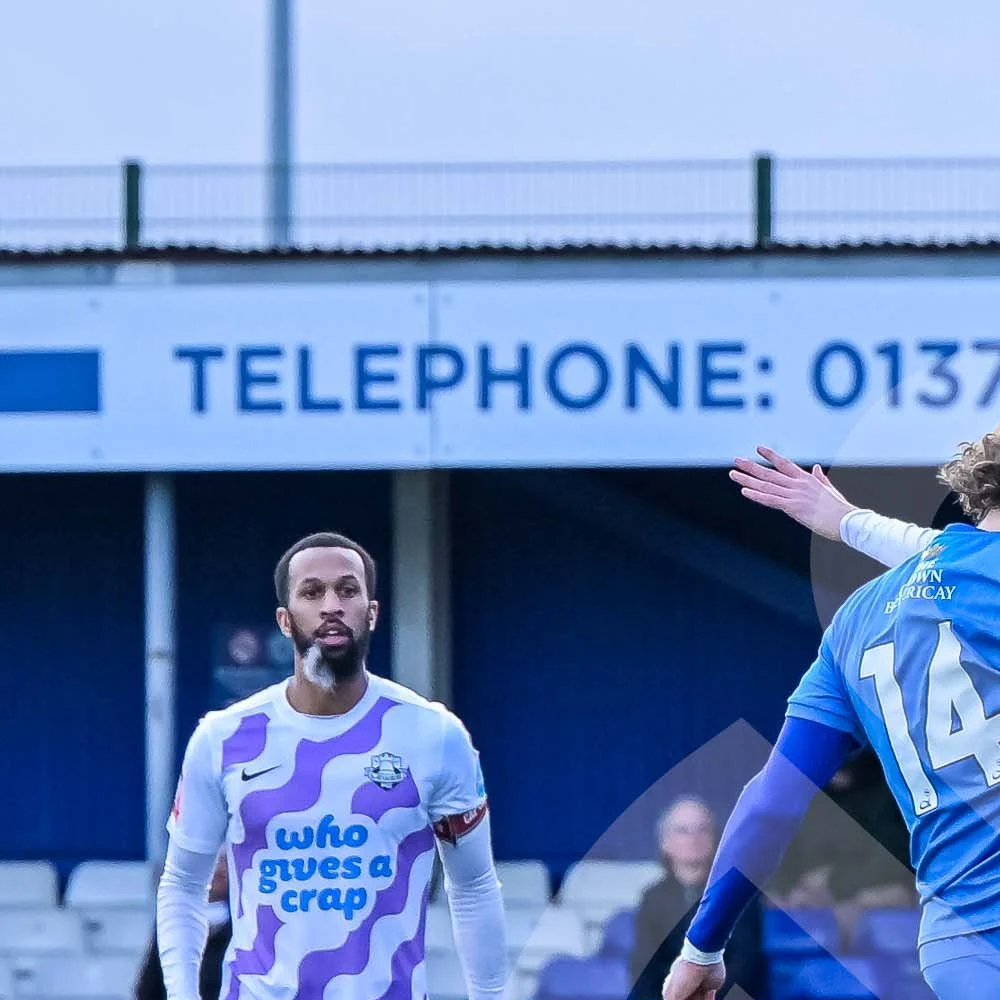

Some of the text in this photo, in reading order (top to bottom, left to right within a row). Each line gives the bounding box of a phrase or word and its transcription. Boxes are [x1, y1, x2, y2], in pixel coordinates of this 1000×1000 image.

[173, 341, 773, 412] TELEPHONE:
[275, 814, 369, 851] who
[258, 854, 393, 894] gives a
[280, 887, 368, 921] crap
